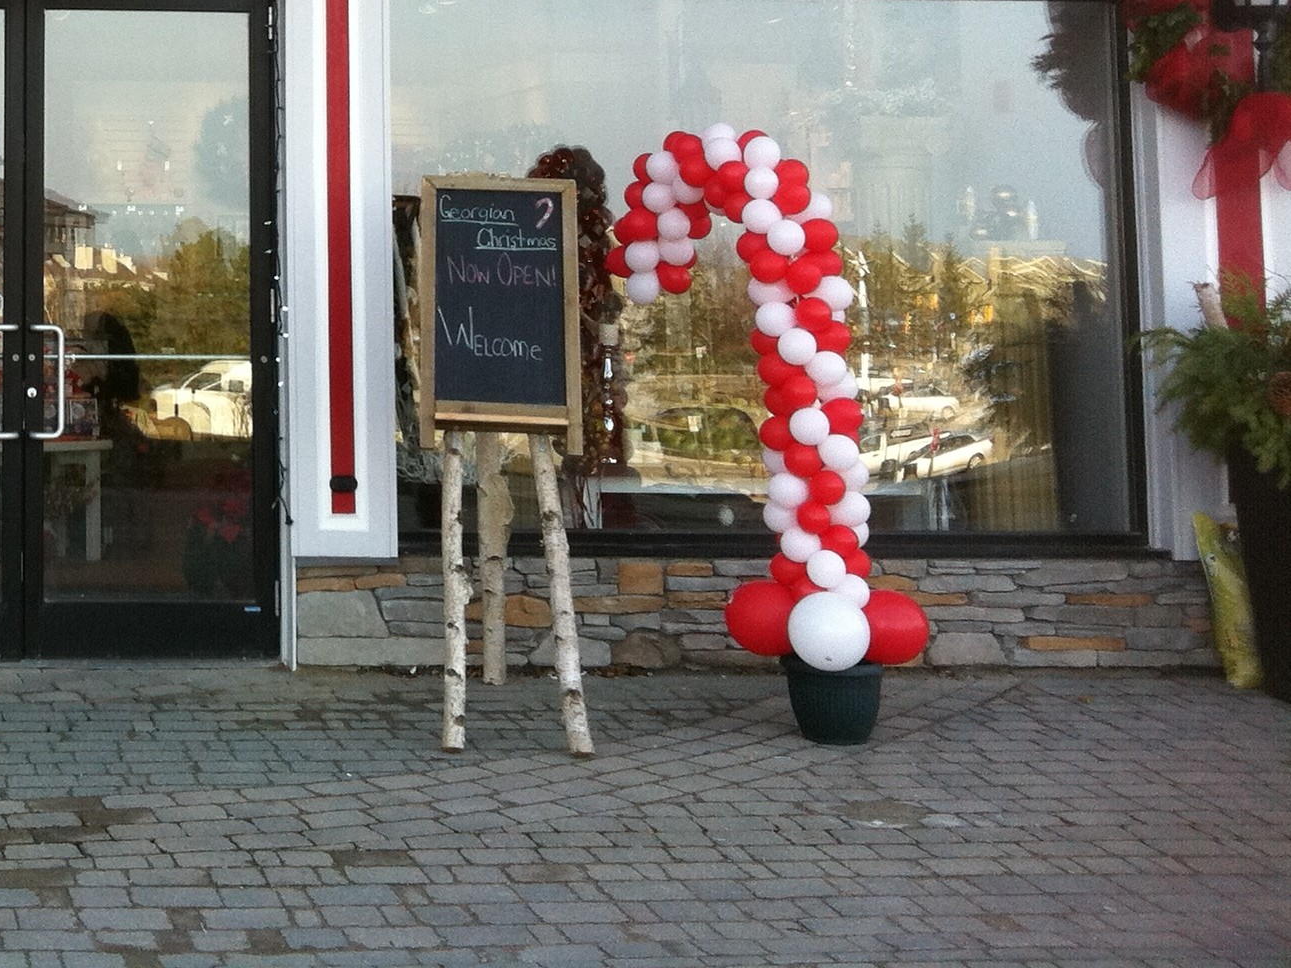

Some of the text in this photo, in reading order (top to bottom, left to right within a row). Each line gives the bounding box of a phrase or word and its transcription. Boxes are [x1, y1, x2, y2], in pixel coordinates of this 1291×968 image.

[439, 194, 516, 224] Georgian
[476, 227, 557, 248] Christmas
[497, 252, 557, 287] OPEN!
